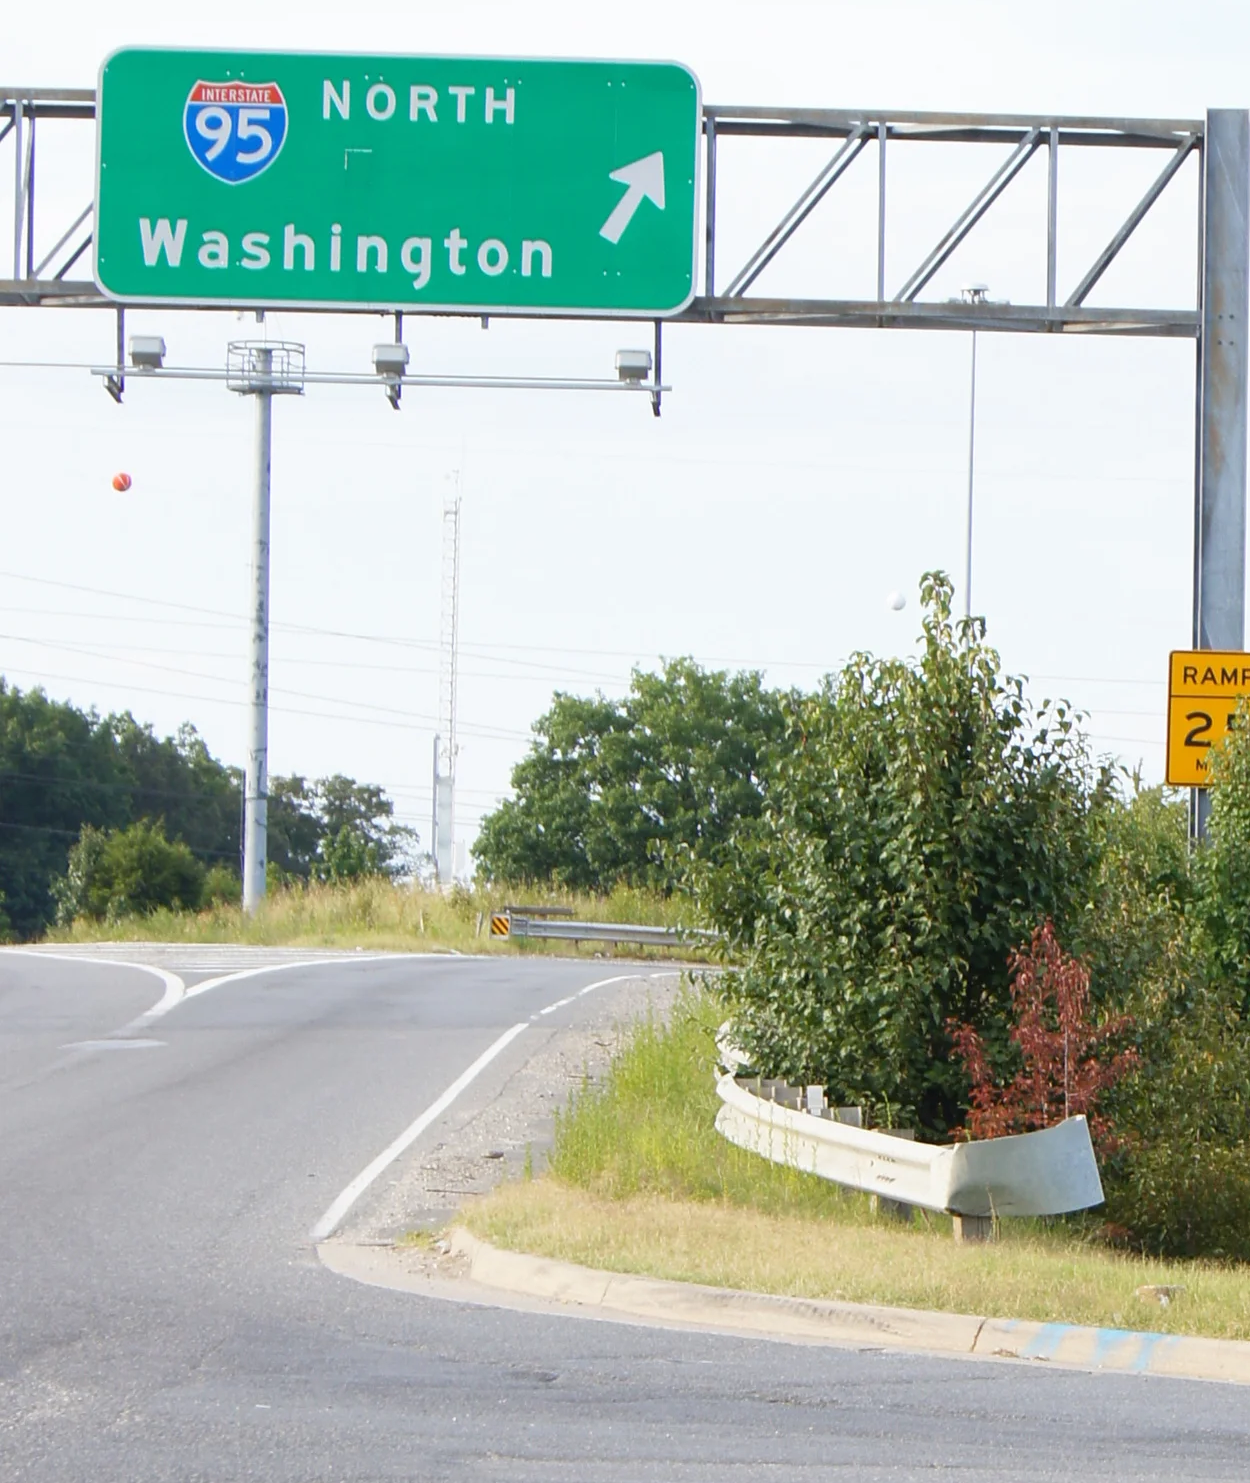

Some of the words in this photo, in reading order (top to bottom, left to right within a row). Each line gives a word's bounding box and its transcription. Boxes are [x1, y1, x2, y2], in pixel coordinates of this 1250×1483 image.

[201, 87, 272, 103] INTERSTATE
[322, 79, 516, 124] NORTH
[195, 105, 273, 164] 95
[139, 217, 553, 290] Washington
